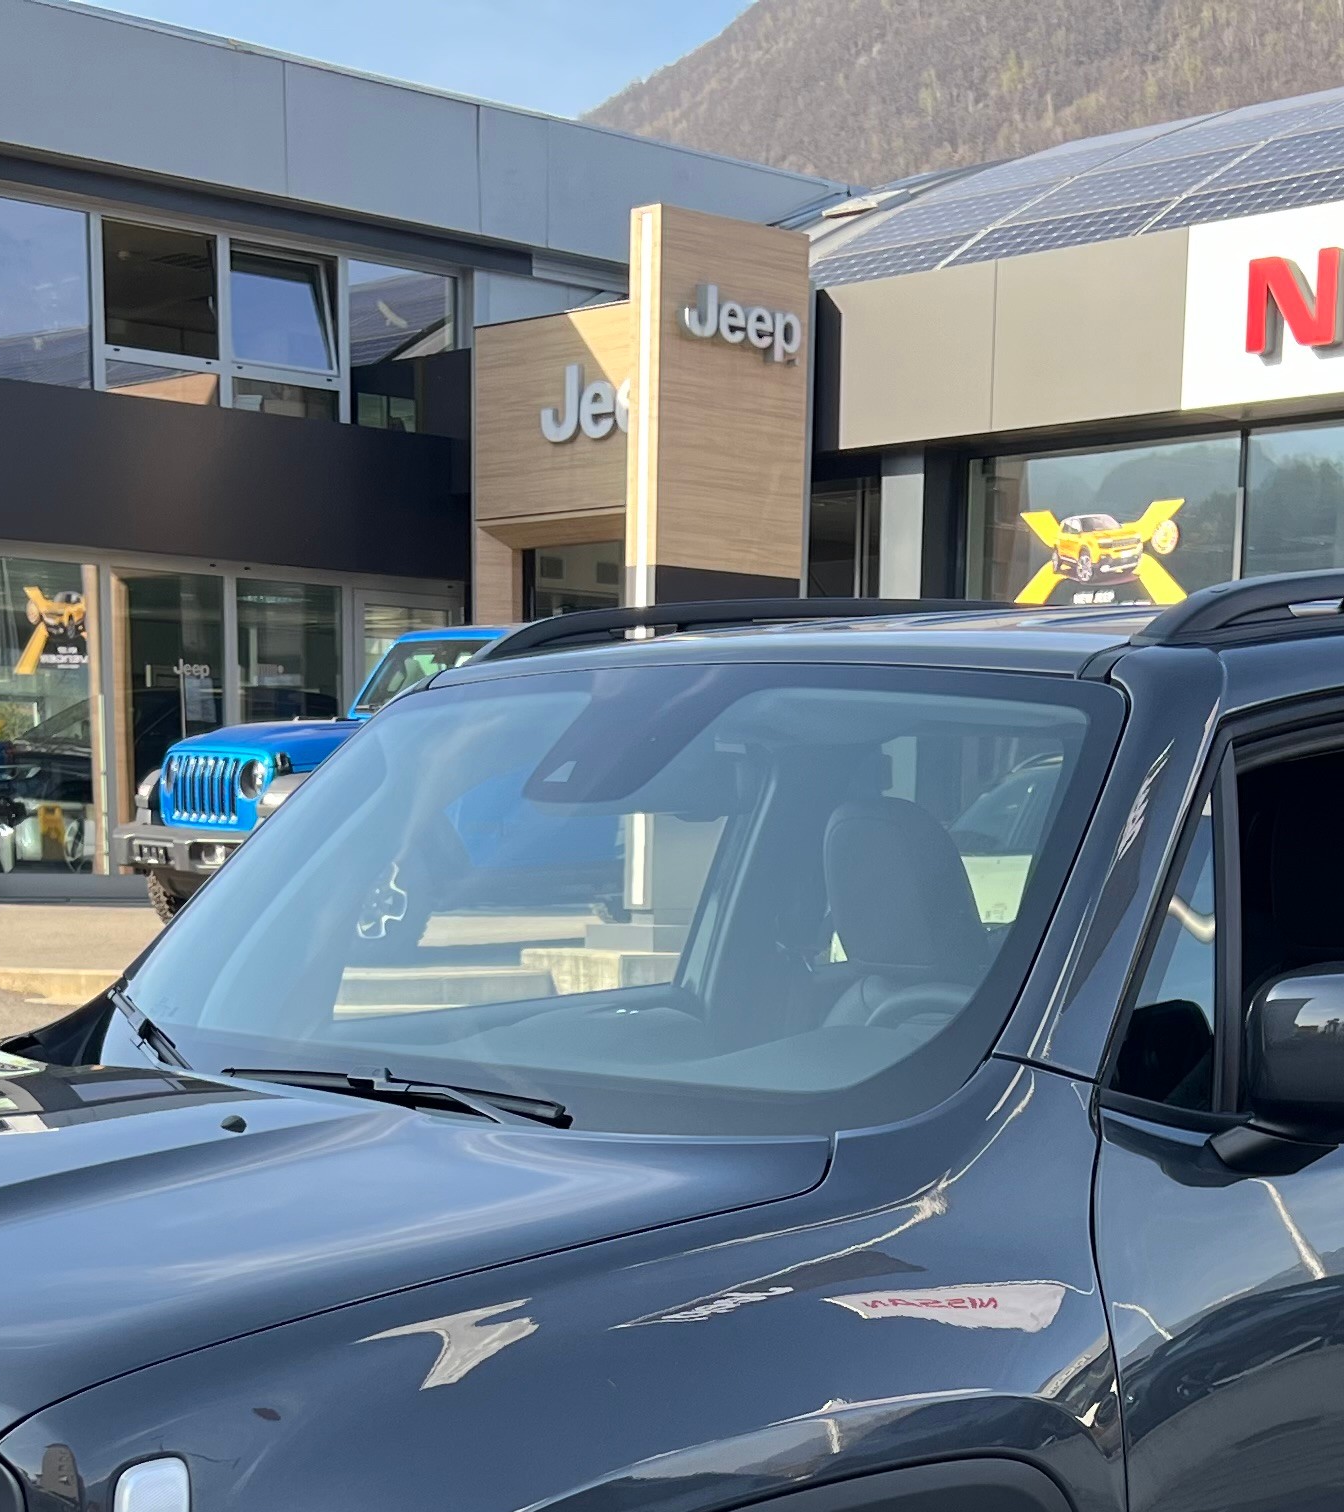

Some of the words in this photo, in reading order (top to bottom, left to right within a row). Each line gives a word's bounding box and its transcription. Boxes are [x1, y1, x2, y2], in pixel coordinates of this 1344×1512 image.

[682, 283, 802, 363] Jeep
[540, 363, 630, 443] Je
[173, 658, 210, 679] Jeep
